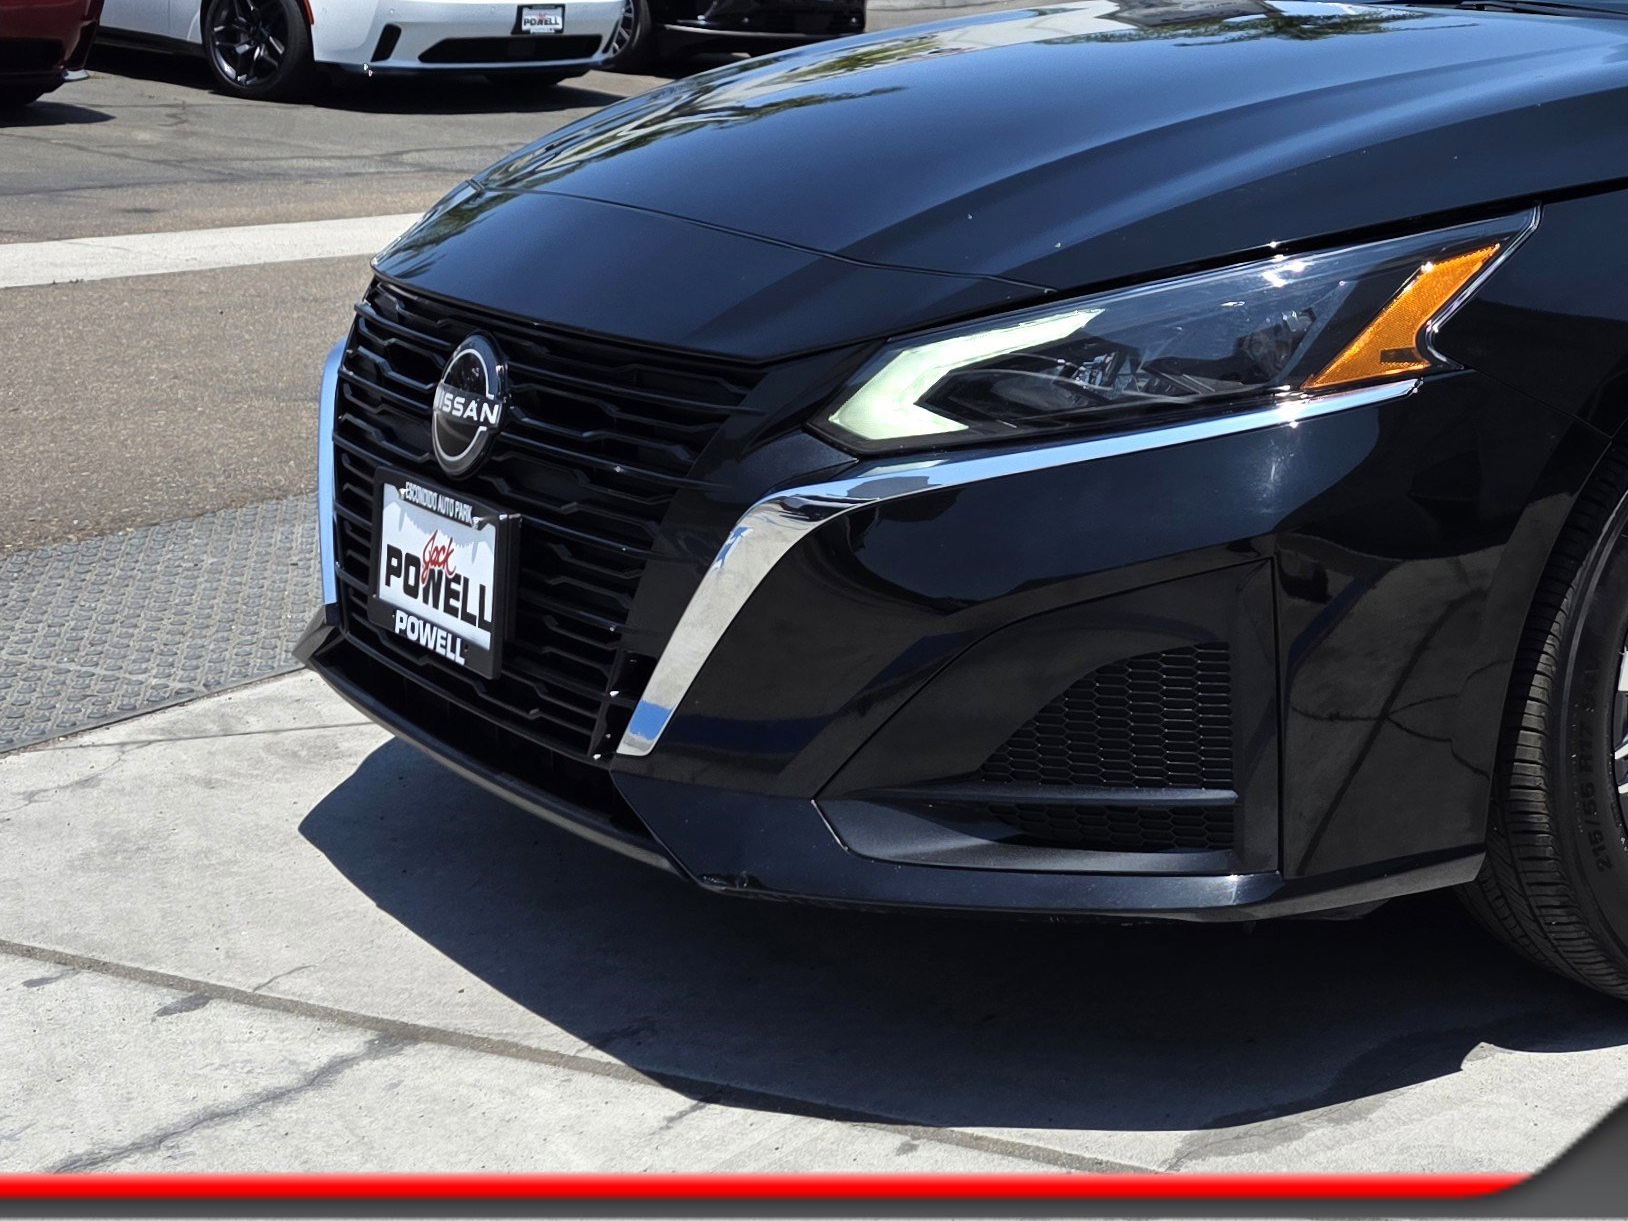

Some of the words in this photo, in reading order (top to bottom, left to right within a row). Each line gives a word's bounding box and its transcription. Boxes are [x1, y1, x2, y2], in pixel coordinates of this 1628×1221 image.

[405, 481, 439, 511] ESCONDIDO
[437, 494, 455, 518] AUTO
[454, 500, 474, 525] PARK
[420, 529, 457, 585] Jack
[385, 544, 493, 628] POWELL
[394, 609, 466, 666] POWELL
